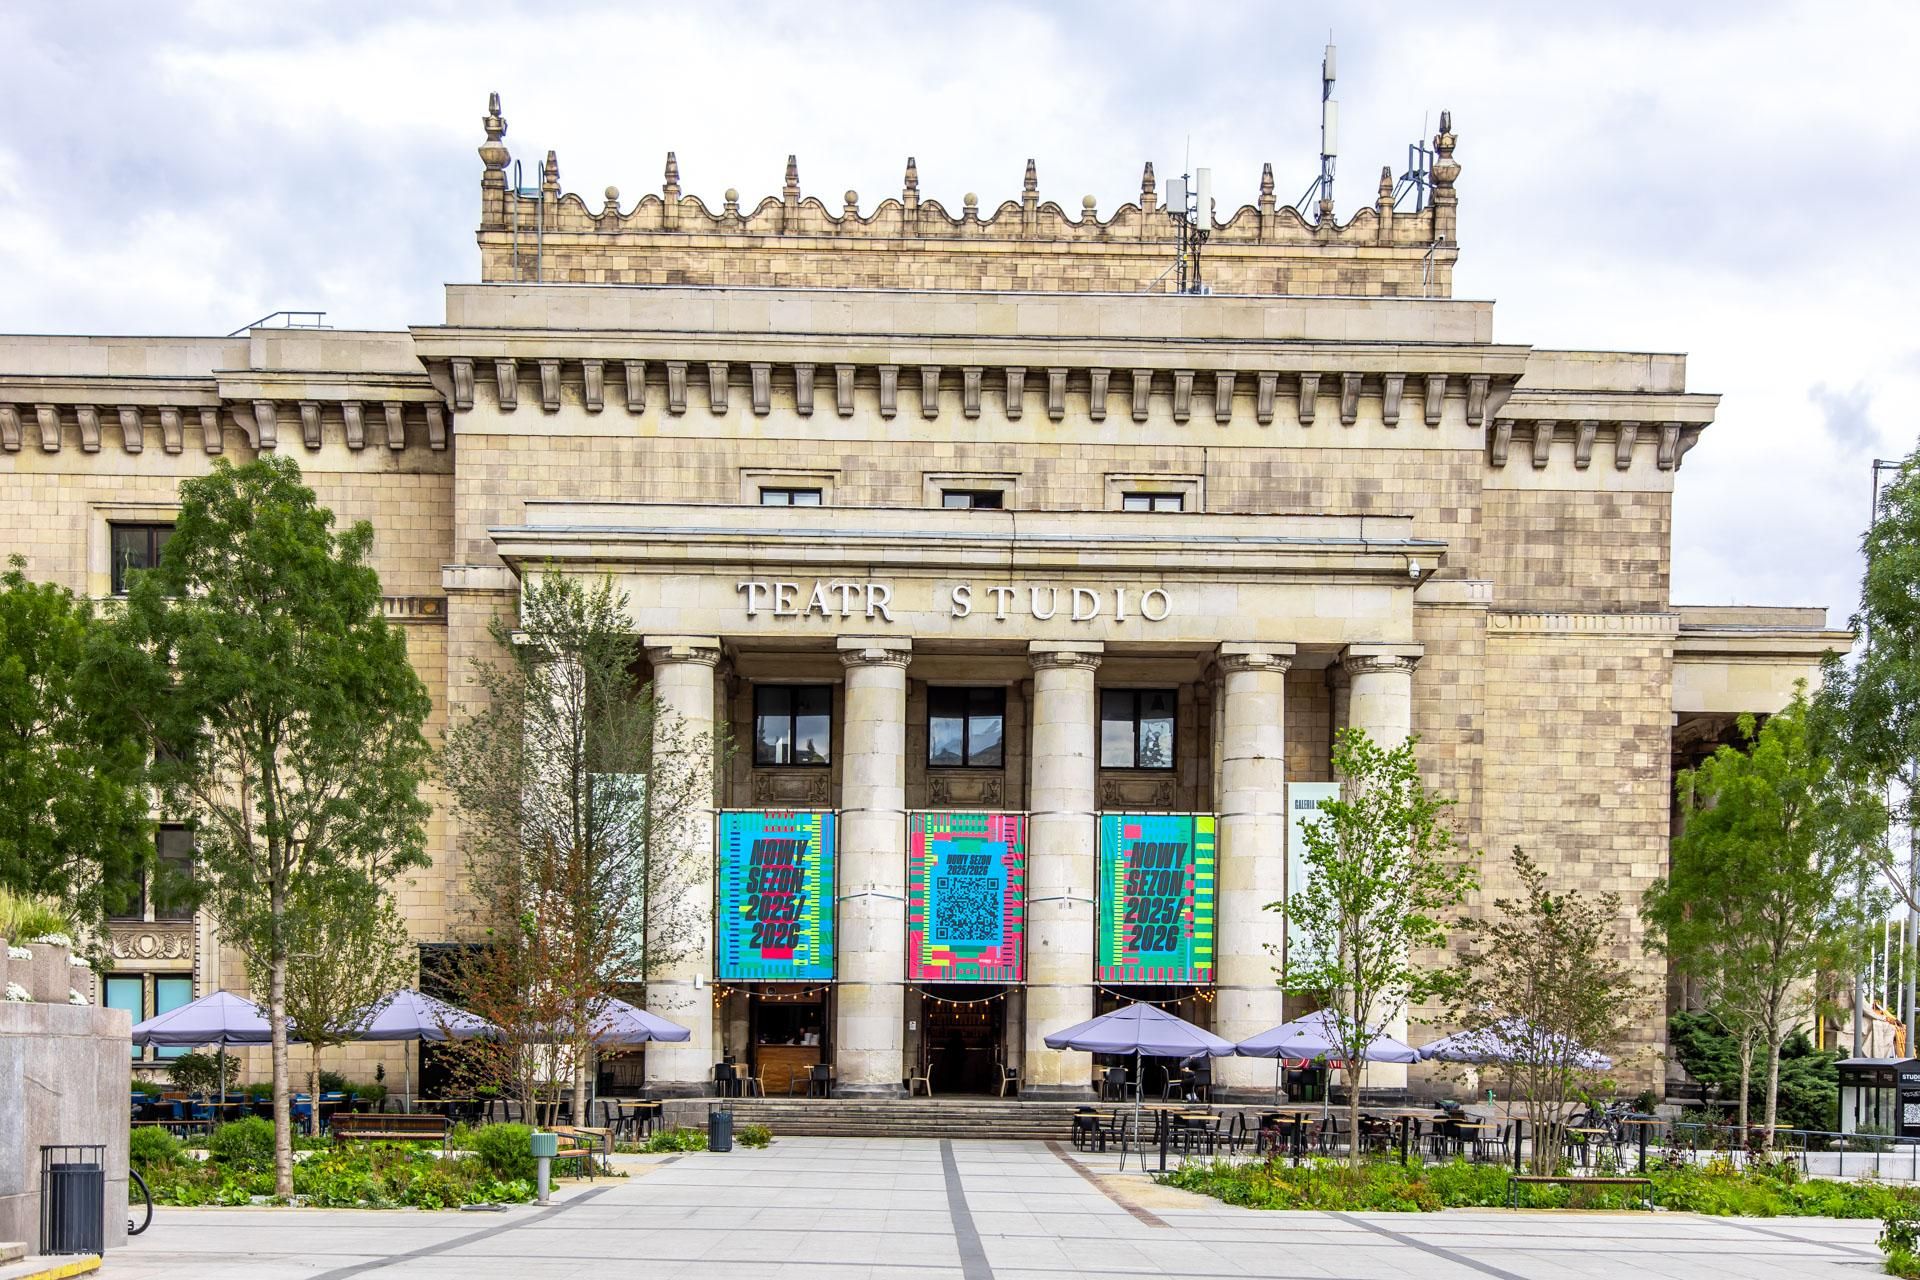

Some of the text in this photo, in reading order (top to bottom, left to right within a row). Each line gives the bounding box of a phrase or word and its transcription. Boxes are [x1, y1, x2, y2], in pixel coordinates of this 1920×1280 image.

[737, 579, 1172, 622] TEATR STUDIO
[749, 839, 809, 866] NOWY
[946, 854, 992, 866] NOWY SEZON
[1129, 842, 1189, 869] NOWY
[746, 866, 806, 894] SEZON
[947, 865, 989, 875] 2025/2026
[1125, 869, 1185, 896] SEZON
[744, 894, 807, 922] 2025/
[1123, 897, 1186, 924] 2025/
[749, 922, 801, 949] 2026
[1128, 925, 1179, 952] 2026
